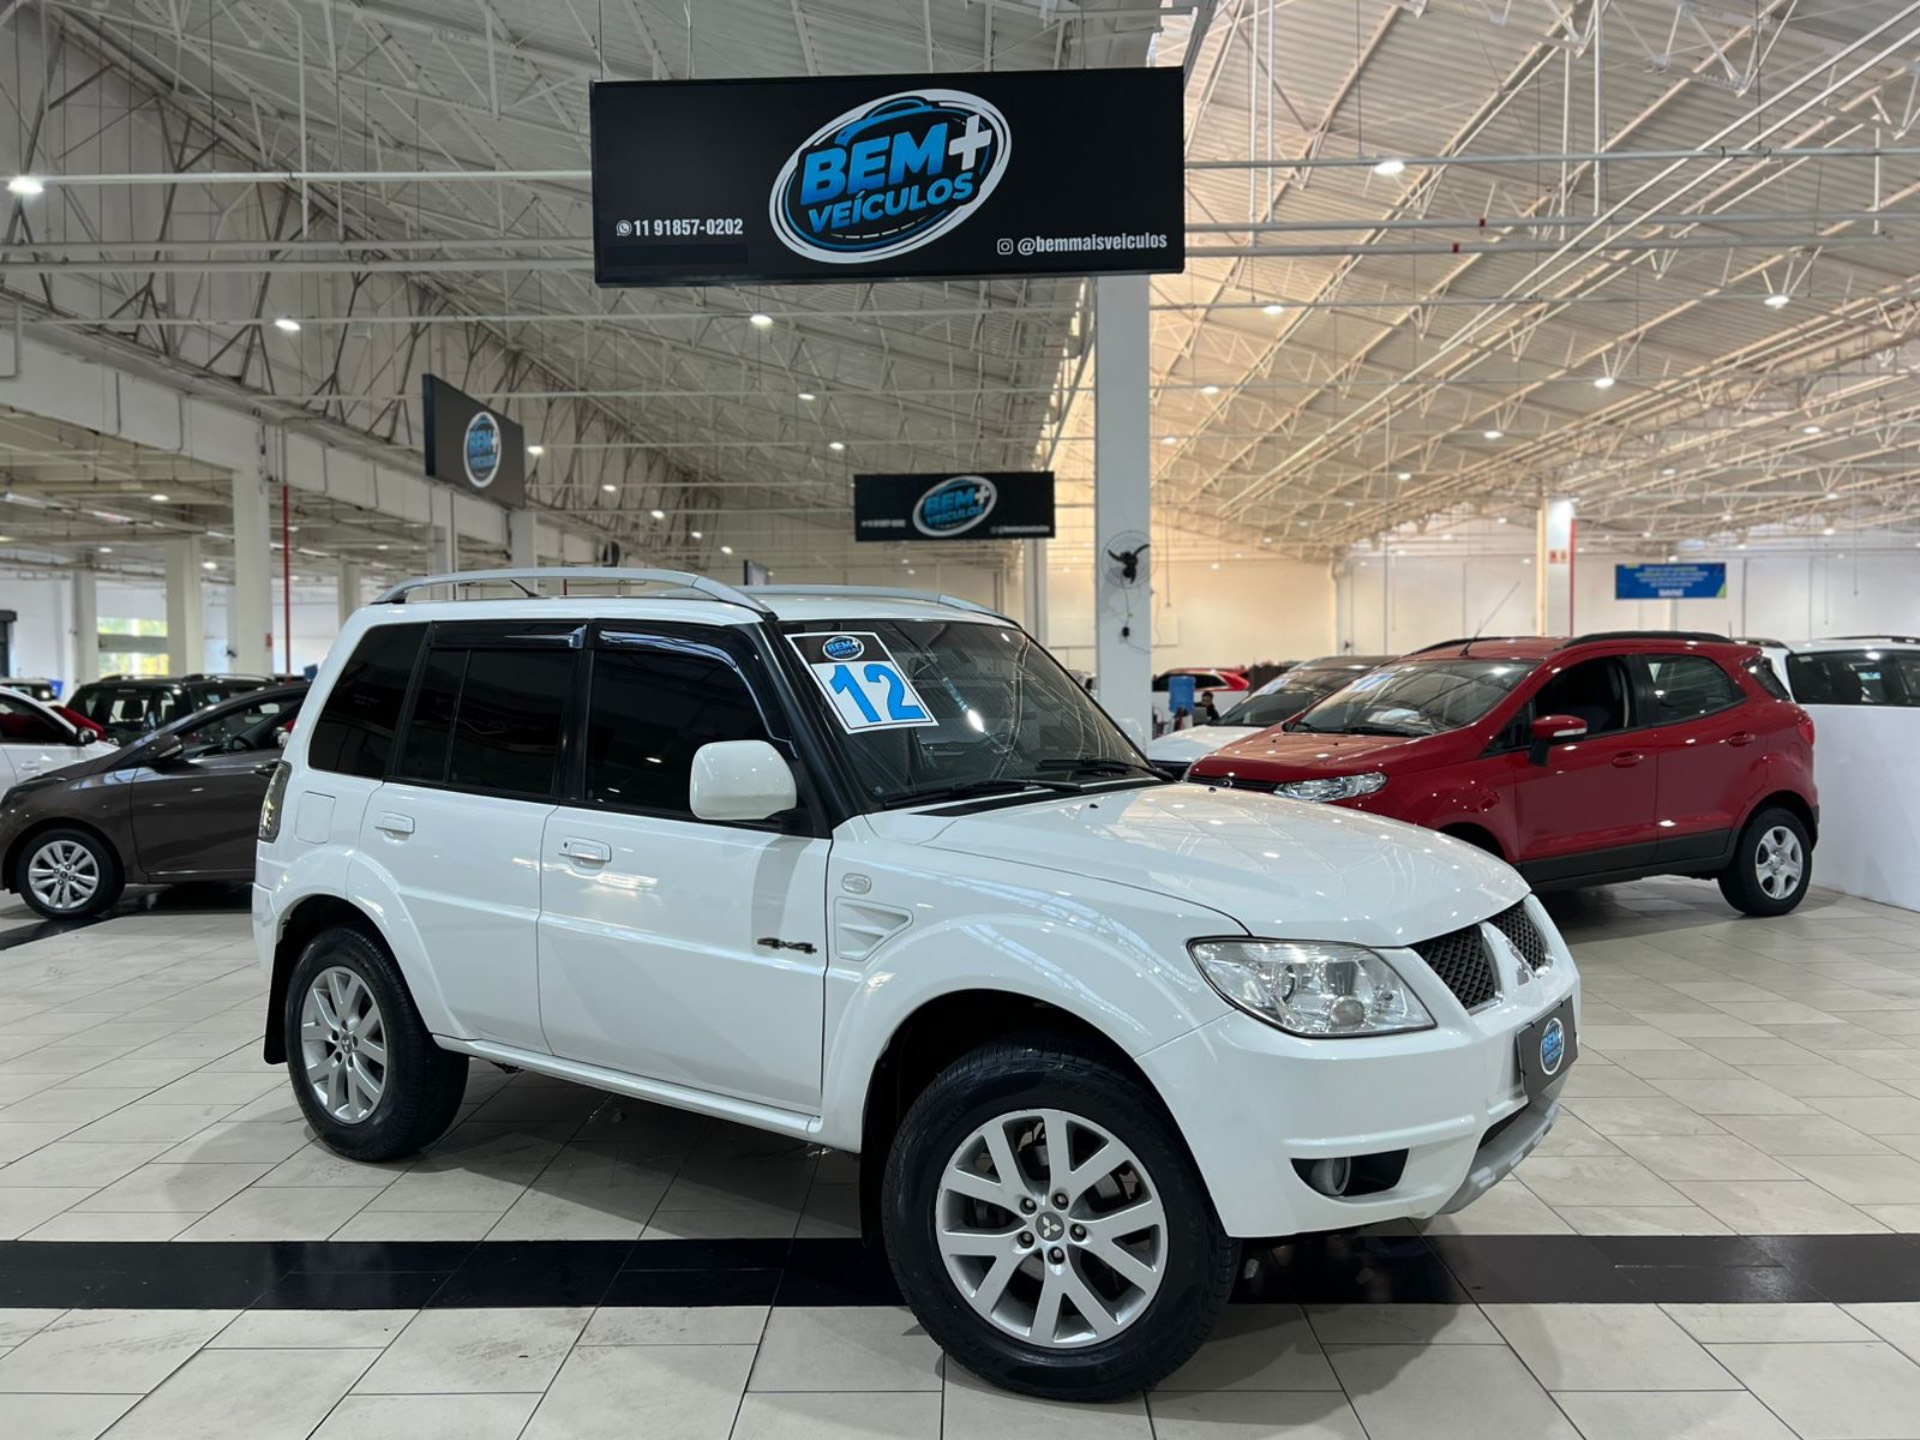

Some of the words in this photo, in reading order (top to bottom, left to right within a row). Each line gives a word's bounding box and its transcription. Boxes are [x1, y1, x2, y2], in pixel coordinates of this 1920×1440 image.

[808, 171, 974, 233] VEÍCULOS
[633, 219, 649, 236] 11
[653, 218, 743, 236] 91857-0202
[1017, 232, 1168, 256] @bemmaisveiculos
[829, 664, 927, 723] 12
